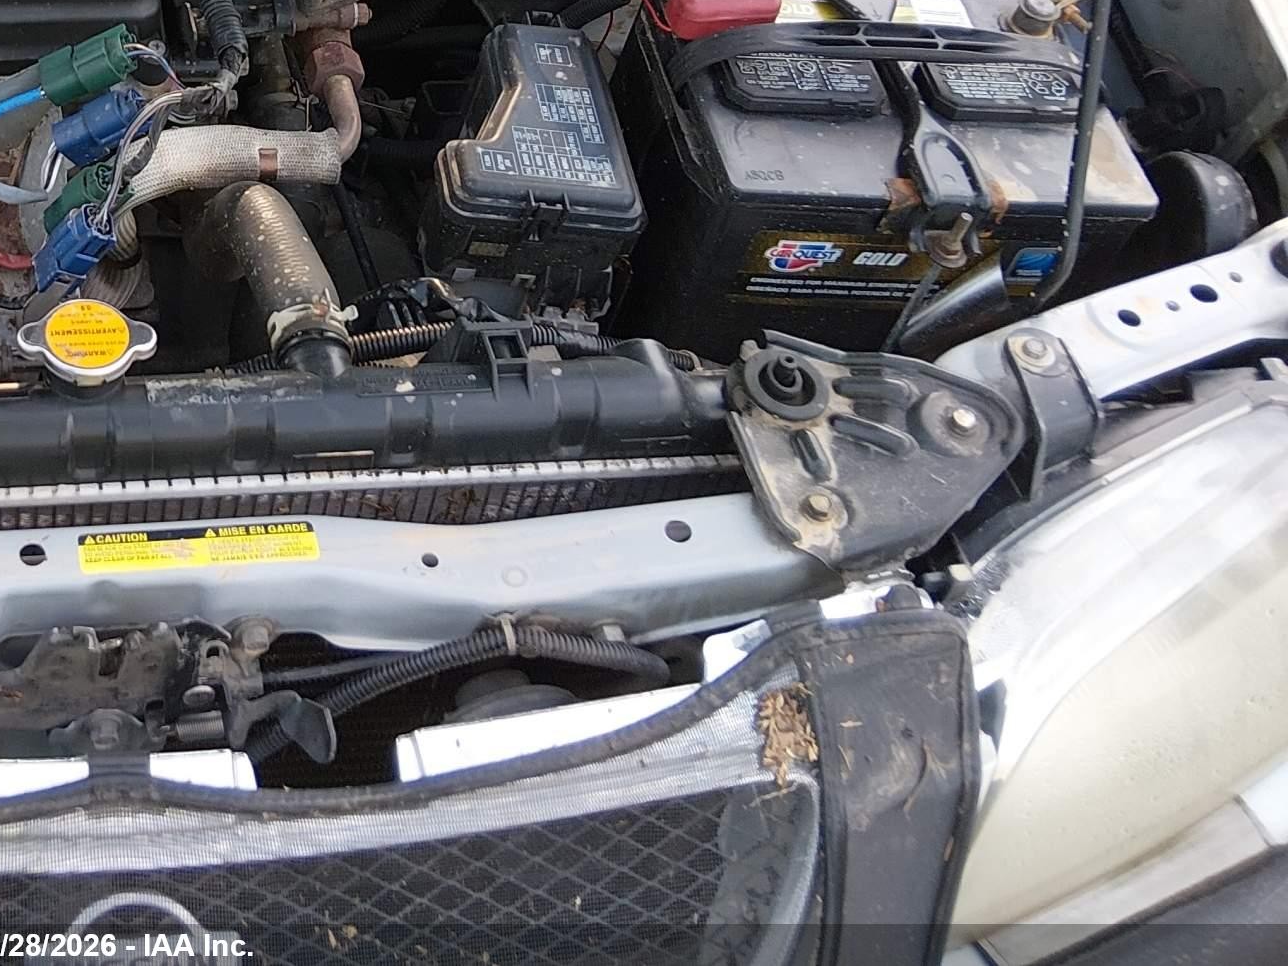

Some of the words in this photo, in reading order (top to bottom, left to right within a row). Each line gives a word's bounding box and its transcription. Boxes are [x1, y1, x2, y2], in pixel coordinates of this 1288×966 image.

[852, 251, 909, 267] GOLD
[218, 526, 247, 537] MISE
[249, 525, 265, 534] EN
[267, 523, 308, 533] GARDE
[95, 532, 148, 544] CAUTION
